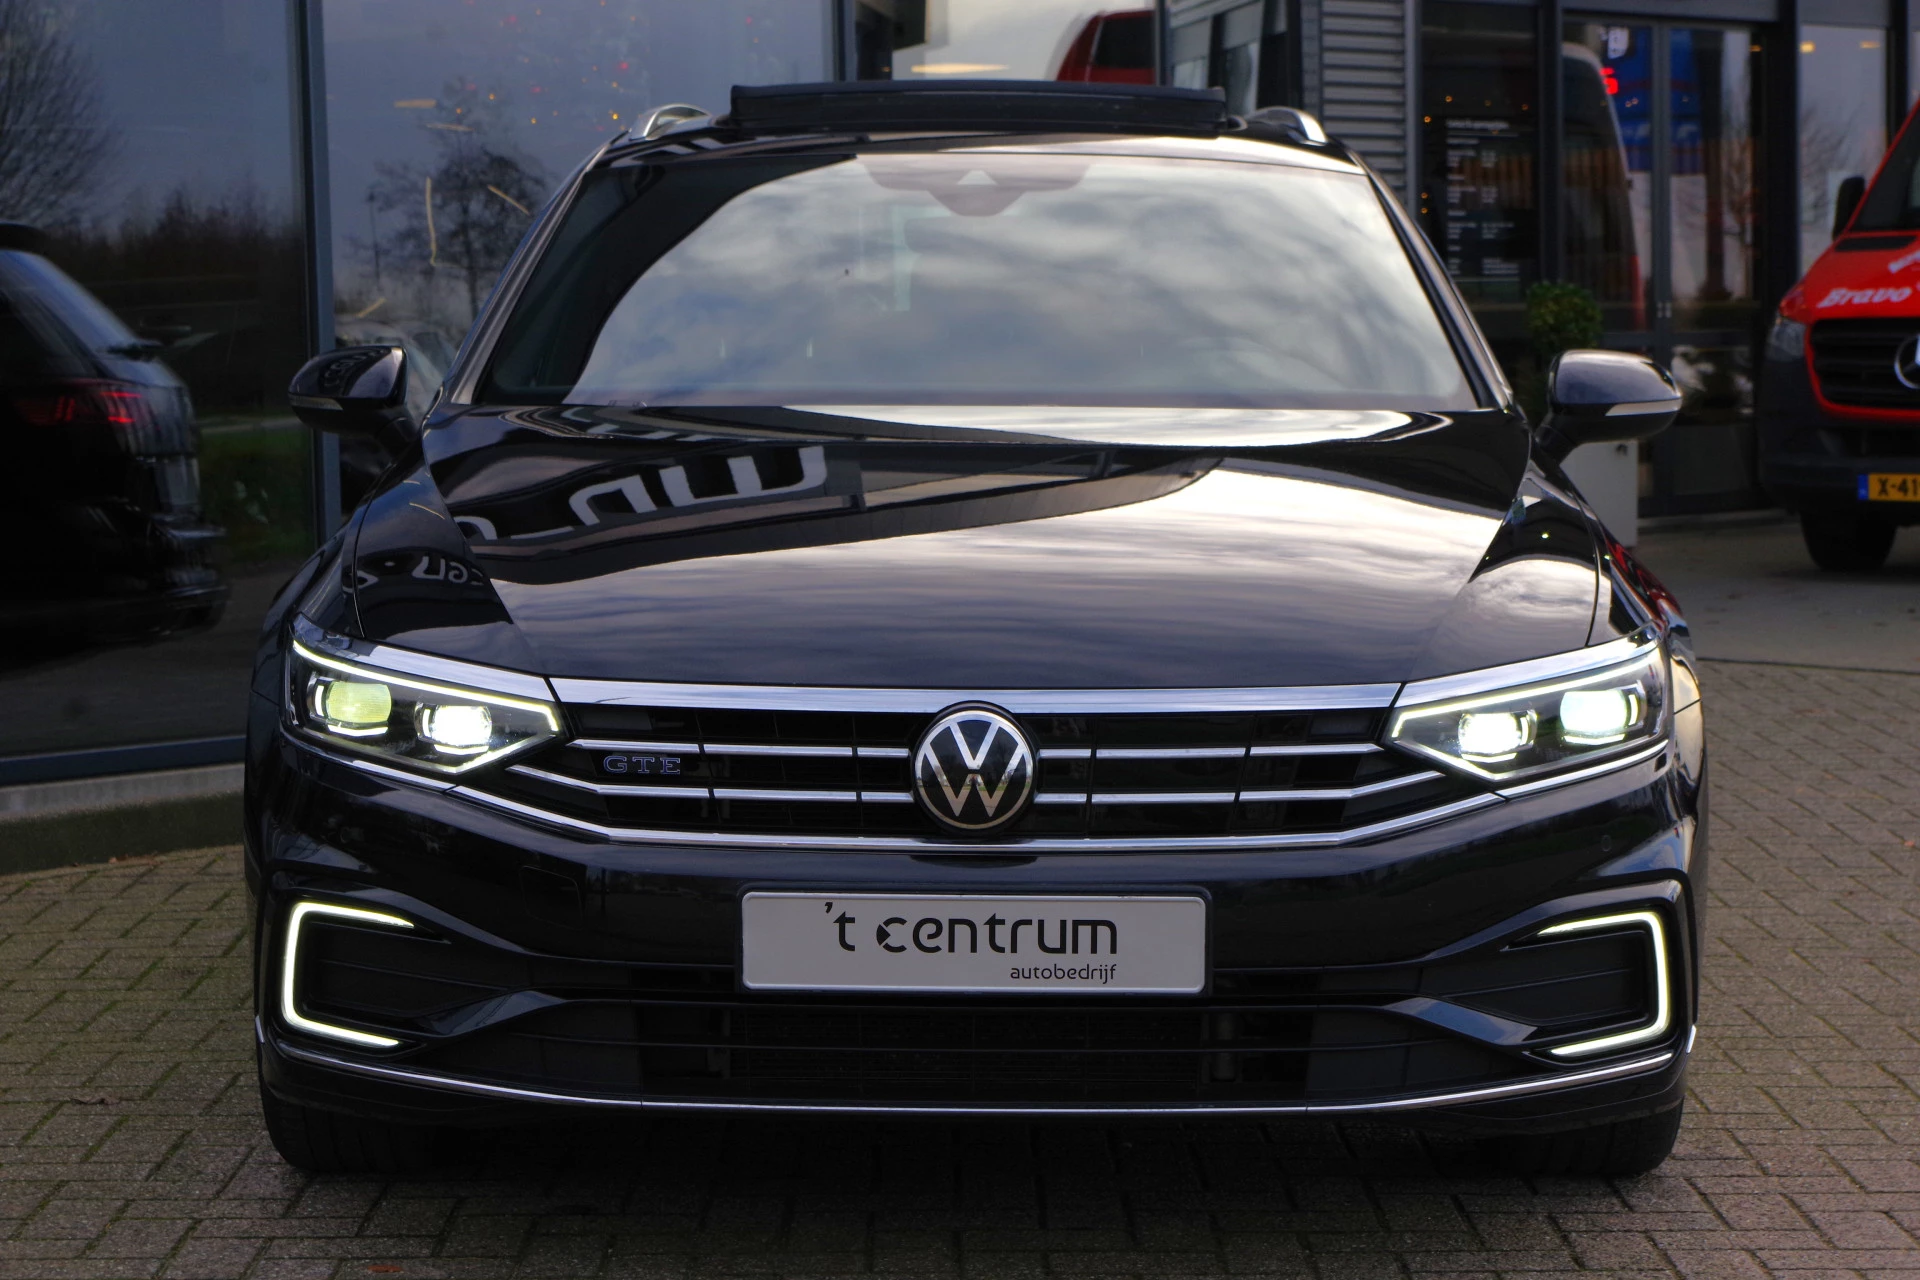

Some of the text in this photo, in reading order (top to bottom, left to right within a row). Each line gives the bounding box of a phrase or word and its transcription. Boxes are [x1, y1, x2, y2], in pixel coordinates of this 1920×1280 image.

[1817, 286, 1912, 308] Bravo
[1877, 476, 1920, 497] X-41
[603, 755, 681, 775] GTE
[876, 912, 1117, 954] centrum
[1009, 963, 1117, 984] autobedrijf
